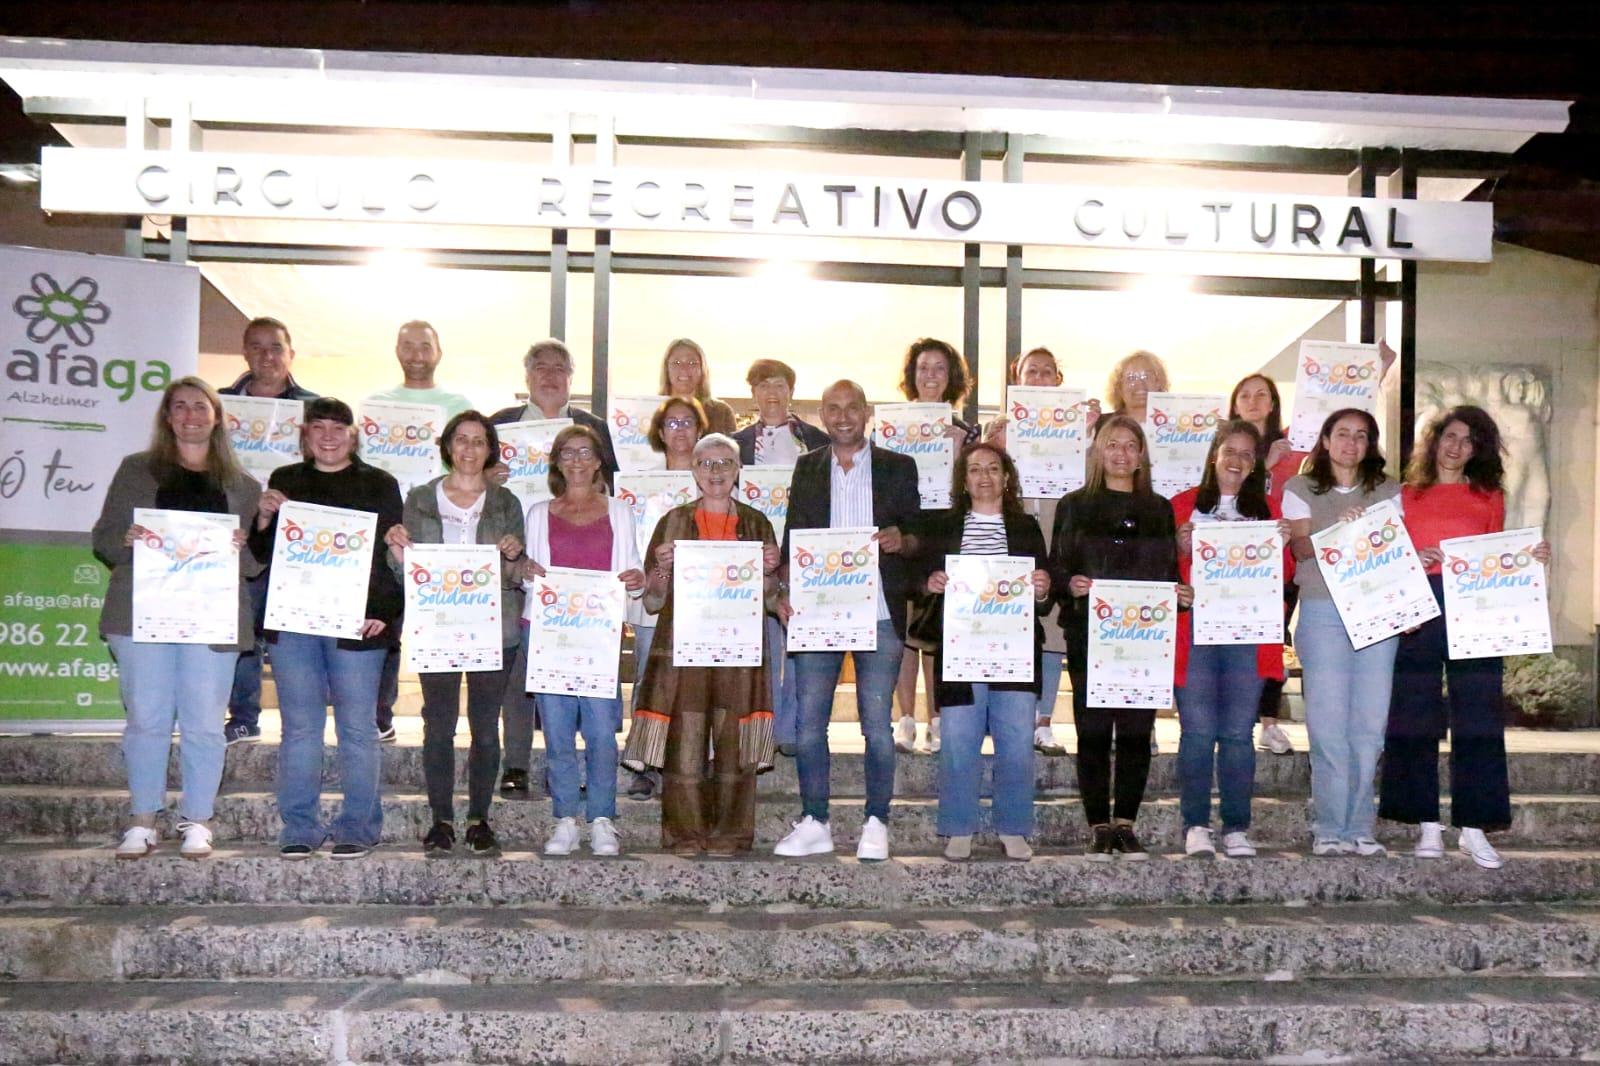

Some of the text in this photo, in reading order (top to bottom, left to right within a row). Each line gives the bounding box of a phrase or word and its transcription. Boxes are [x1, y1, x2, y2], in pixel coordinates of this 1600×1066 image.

[136, 165, 1414, 249] CIRCULO RECREATIVO CULTURAL
[6, 344, 172, 403] afaga
[7, 391, 100, 409] Alzheimer
[56, 623, 89, 647] 22
[1100, 618, 1167, 641] Solidario
